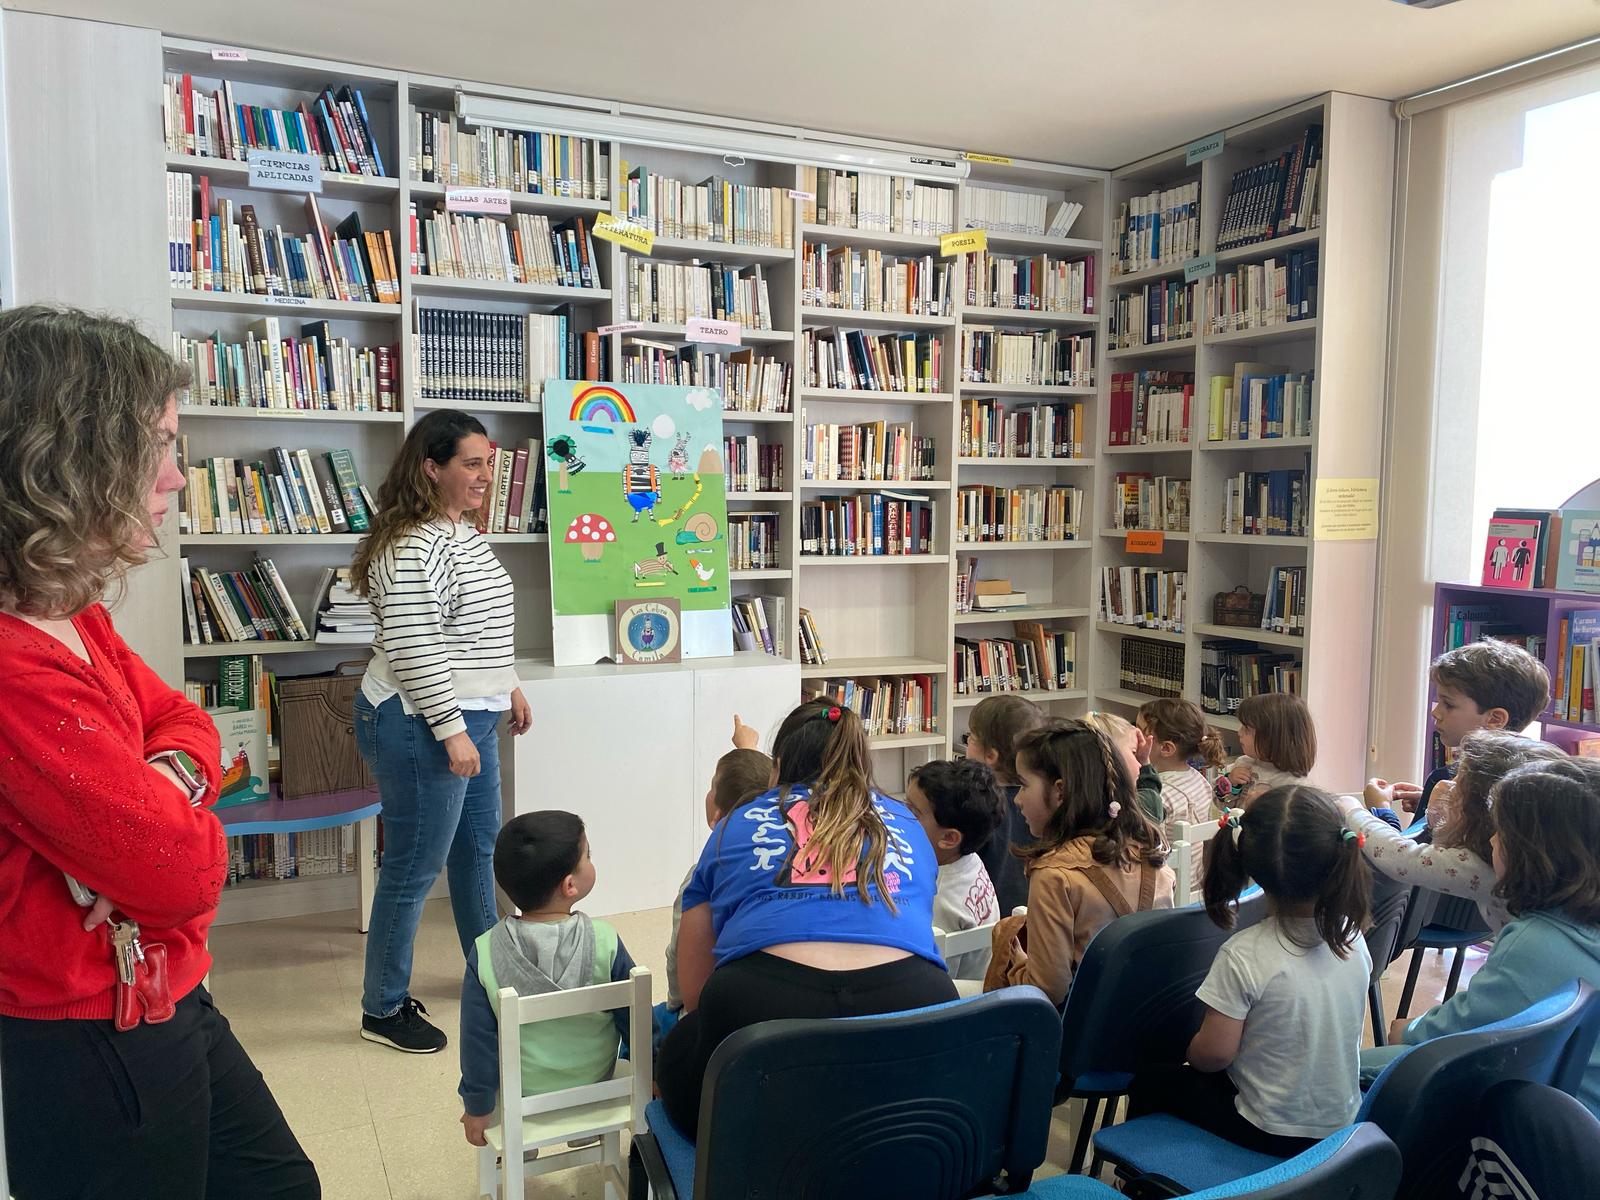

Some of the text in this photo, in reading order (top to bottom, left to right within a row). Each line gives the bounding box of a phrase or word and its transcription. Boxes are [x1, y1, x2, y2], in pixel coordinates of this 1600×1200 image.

[260, 160, 310, 171] CIENCIAS
[258, 170, 314, 182] APLICADAS
[600, 222, 648, 245] LITERATURA
[700, 326, 728, 336] TEATRO
[272, 344, 281, 383] FRACTURAS
[503, 454, 511, 472] HOY
[646, 604, 667, 614] Cebra
[632, 650, 664, 660] Camila
[228, 660, 244, 700] AGRICULTURA
